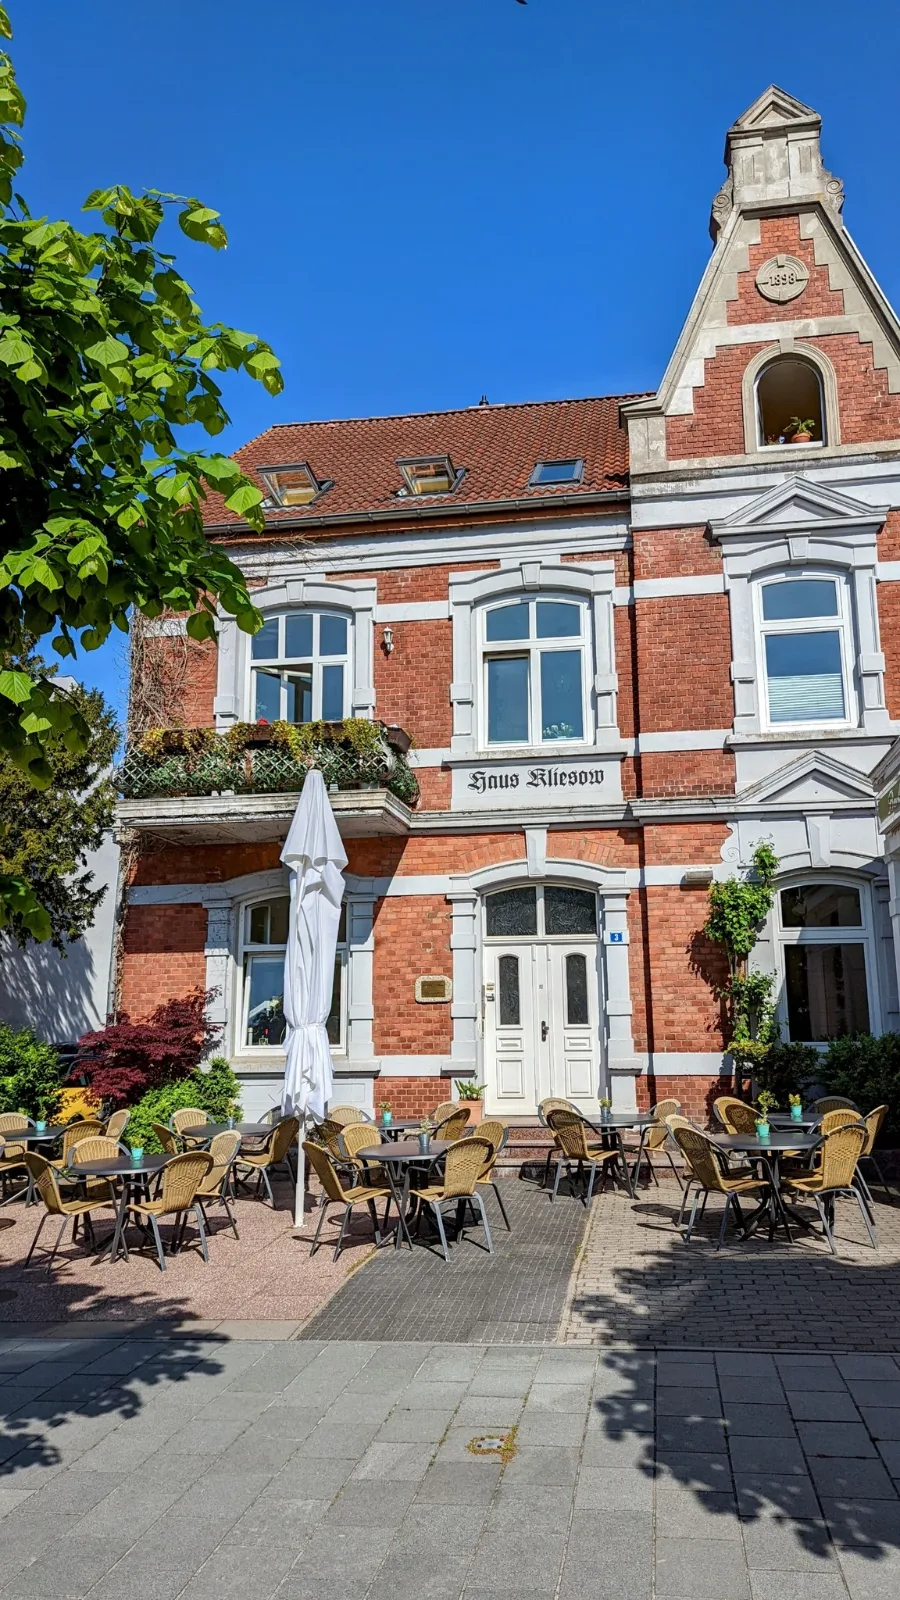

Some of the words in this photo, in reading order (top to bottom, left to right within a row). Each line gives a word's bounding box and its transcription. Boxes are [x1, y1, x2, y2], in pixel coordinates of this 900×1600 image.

[769, 273, 795, 286] 1898
[467, 771, 520, 794] Haus
[526, 767, 604, 788] Kliesow
